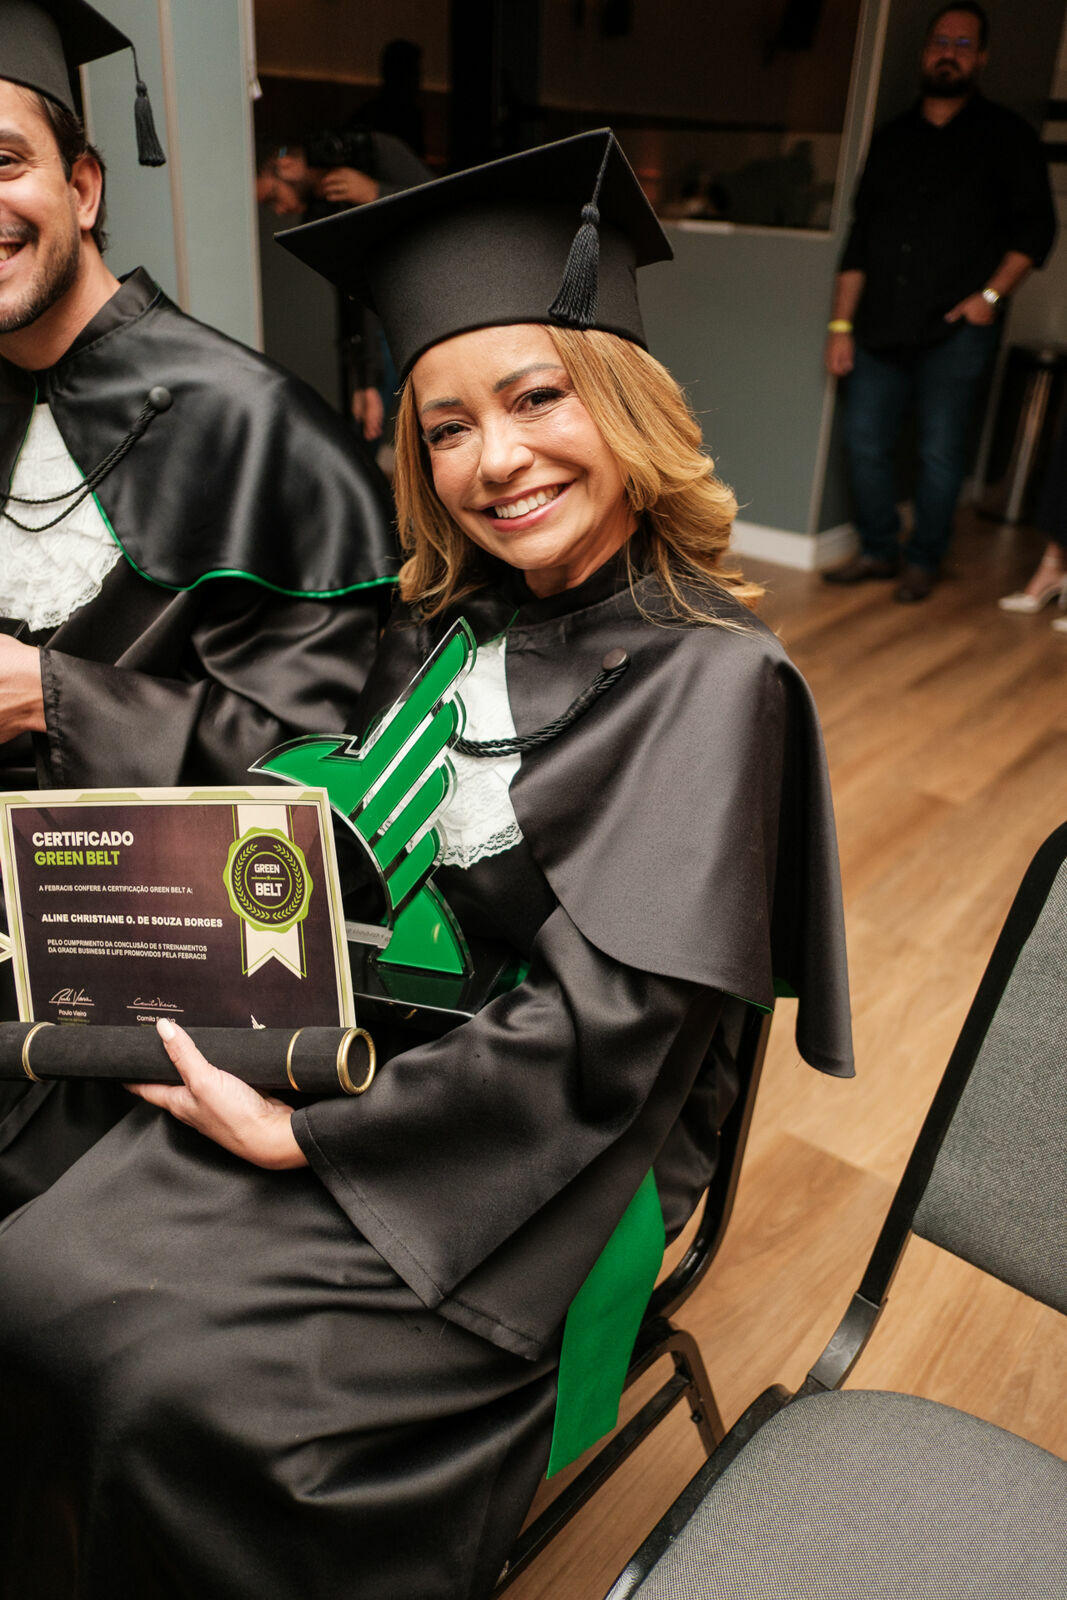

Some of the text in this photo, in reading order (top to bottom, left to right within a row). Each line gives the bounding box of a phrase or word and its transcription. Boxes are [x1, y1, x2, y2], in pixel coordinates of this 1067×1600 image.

[32, 831, 134, 847] CERTIFICADO
[34, 851, 120, 866] GREEN BELT
[254, 863, 280, 874] GREEN
[107, 885, 149, 894] CERTIFICAÇÃO
[255, 882, 283, 897] BELT
[41, 913, 223, 928] ALINE CHRISTIANE O. DE SOUZA BORGES
[63, 939, 104, 947] CUMPRIMENTO
[114, 941, 149, 949] CONCLUSÃO
[162, 943, 207, 952] TREINAMENTOS
[78, 947, 106, 955] BUSINESS
[124, 950, 161, 958] PROMOVIDOS
[161, 951, 178, 959] PELA
[178, 952, 207, 960] FEBRACIS
[58, 1009, 87, 1017] Paulo Vieira
[136, 1014, 156, 1023] Camila
